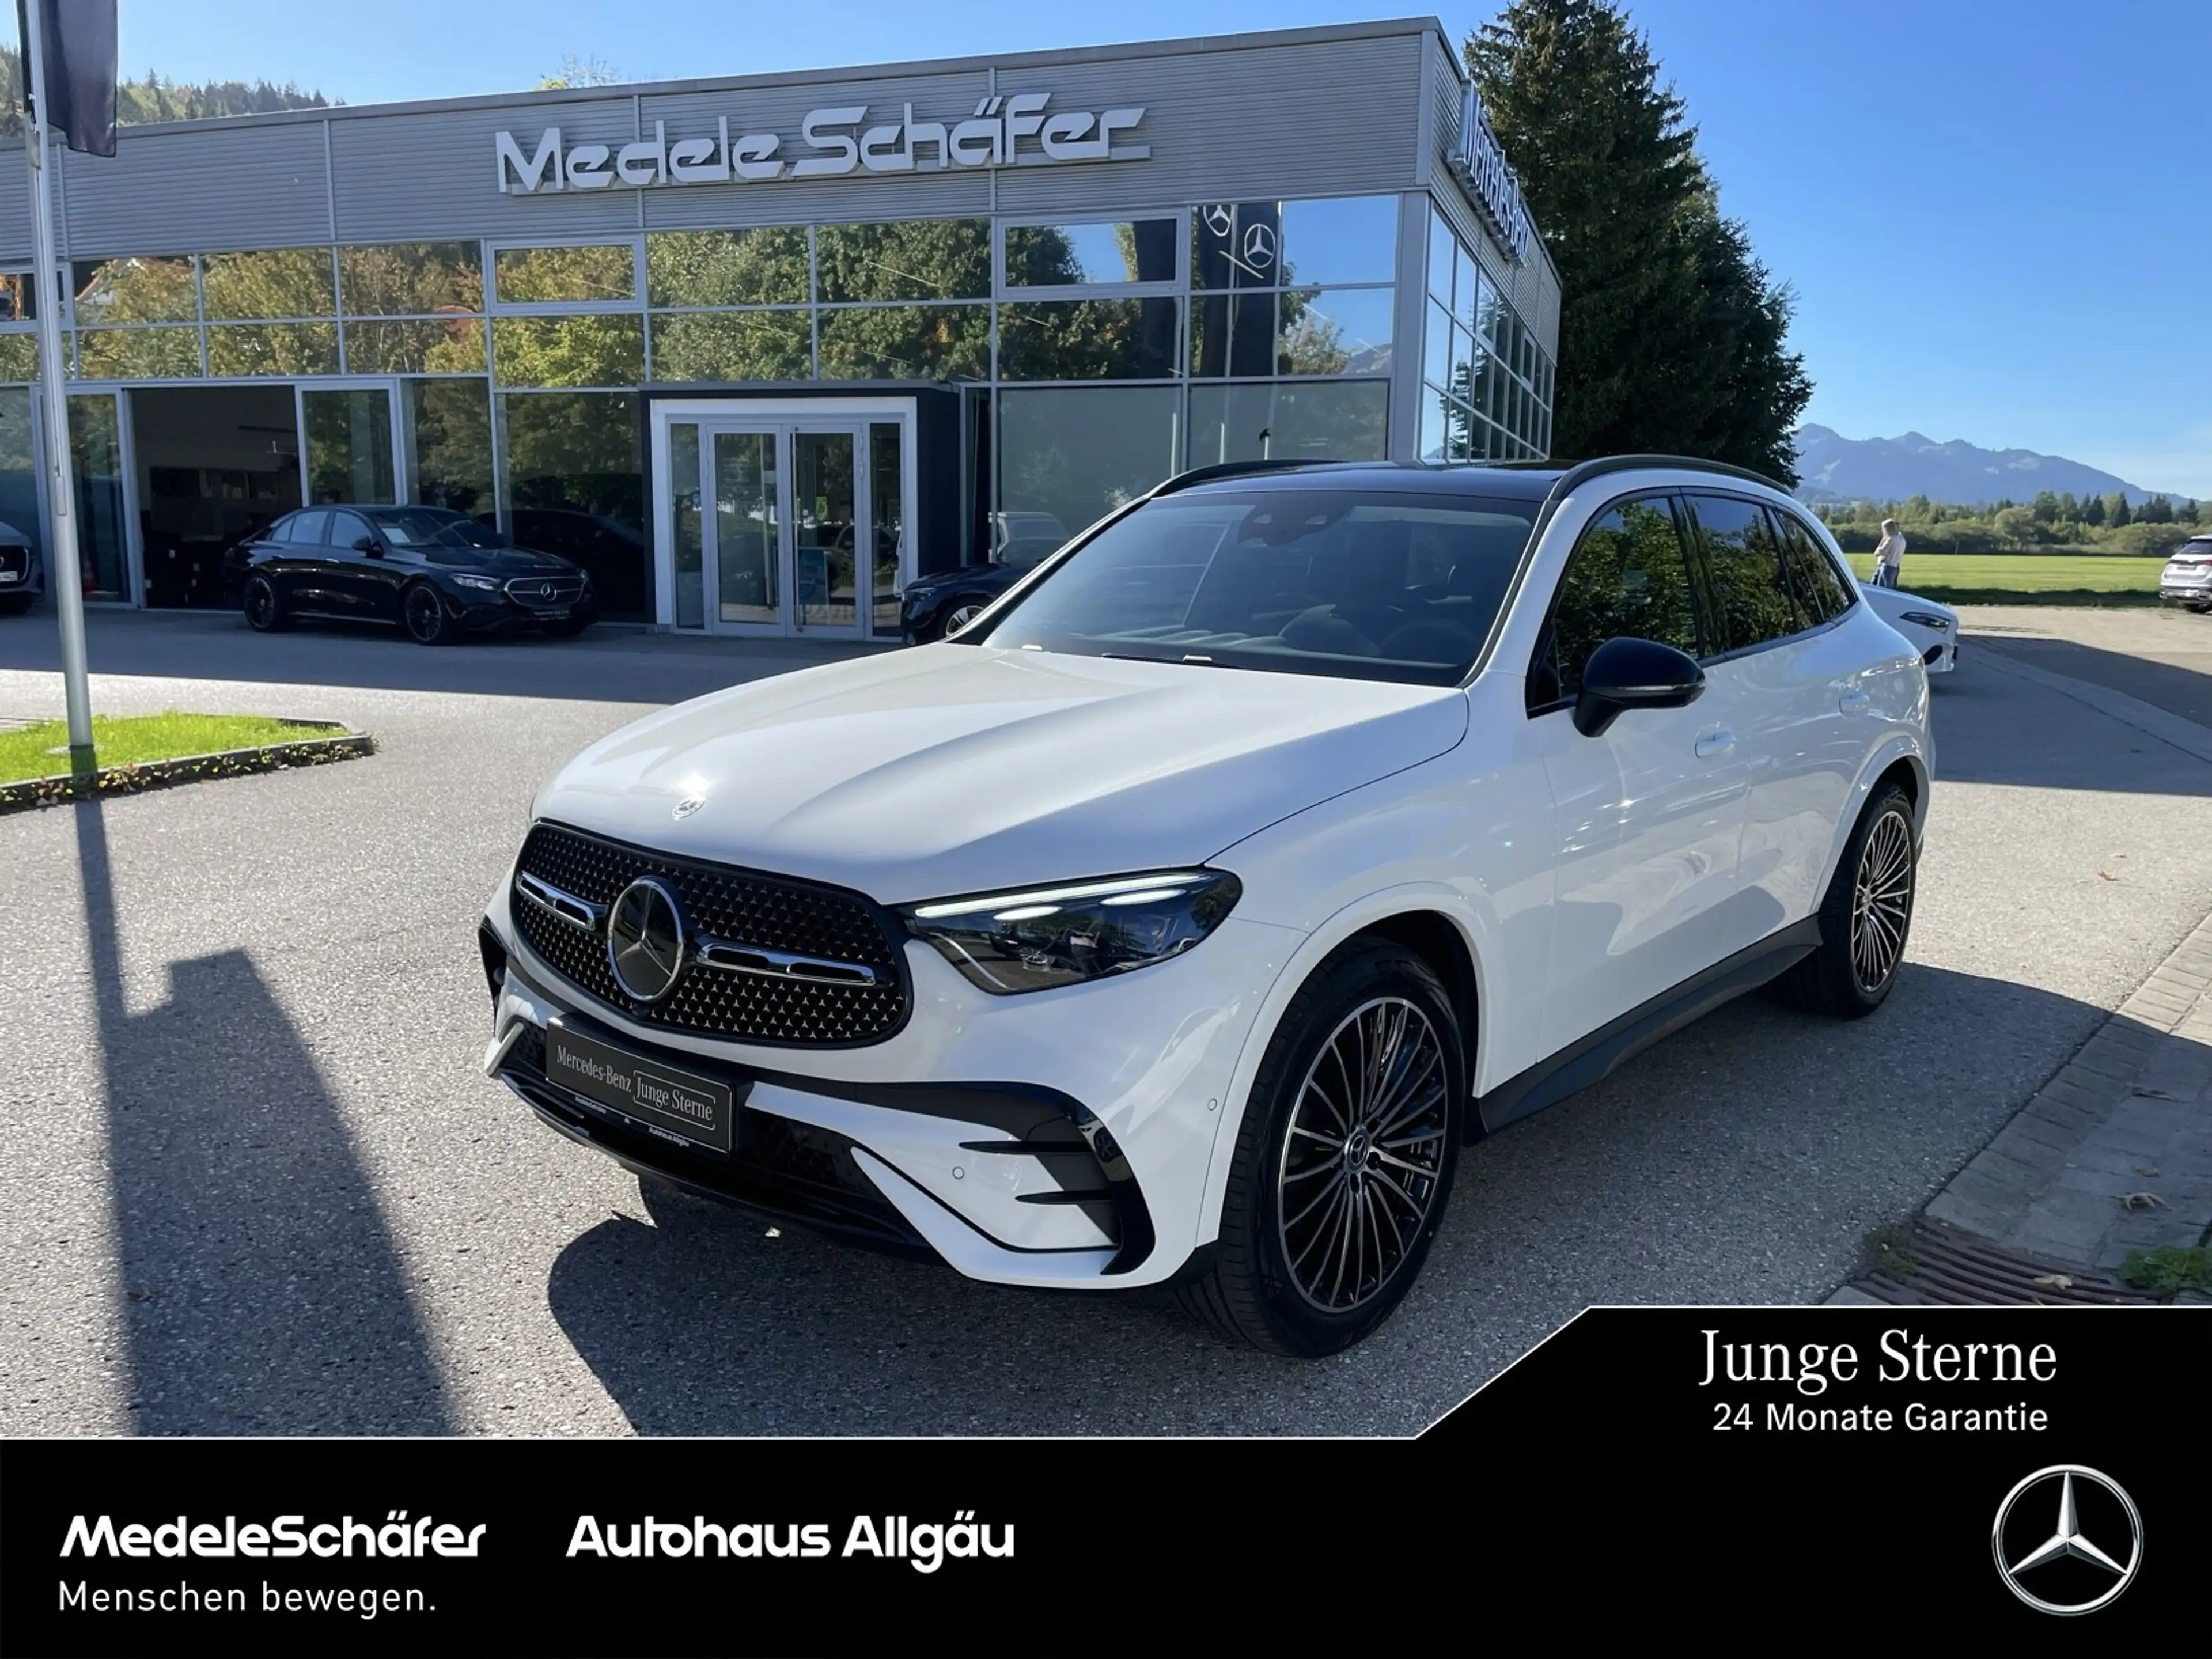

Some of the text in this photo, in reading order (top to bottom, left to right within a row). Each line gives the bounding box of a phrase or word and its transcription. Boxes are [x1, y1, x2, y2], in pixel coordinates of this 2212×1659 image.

[495, 92, 1147, 193] Medele Schäfer
[556, 1044, 631, 1093] Mercedes-Benz
[636, 1077, 669, 1108] Junge
[672, 1089, 713, 1122] Sterne
